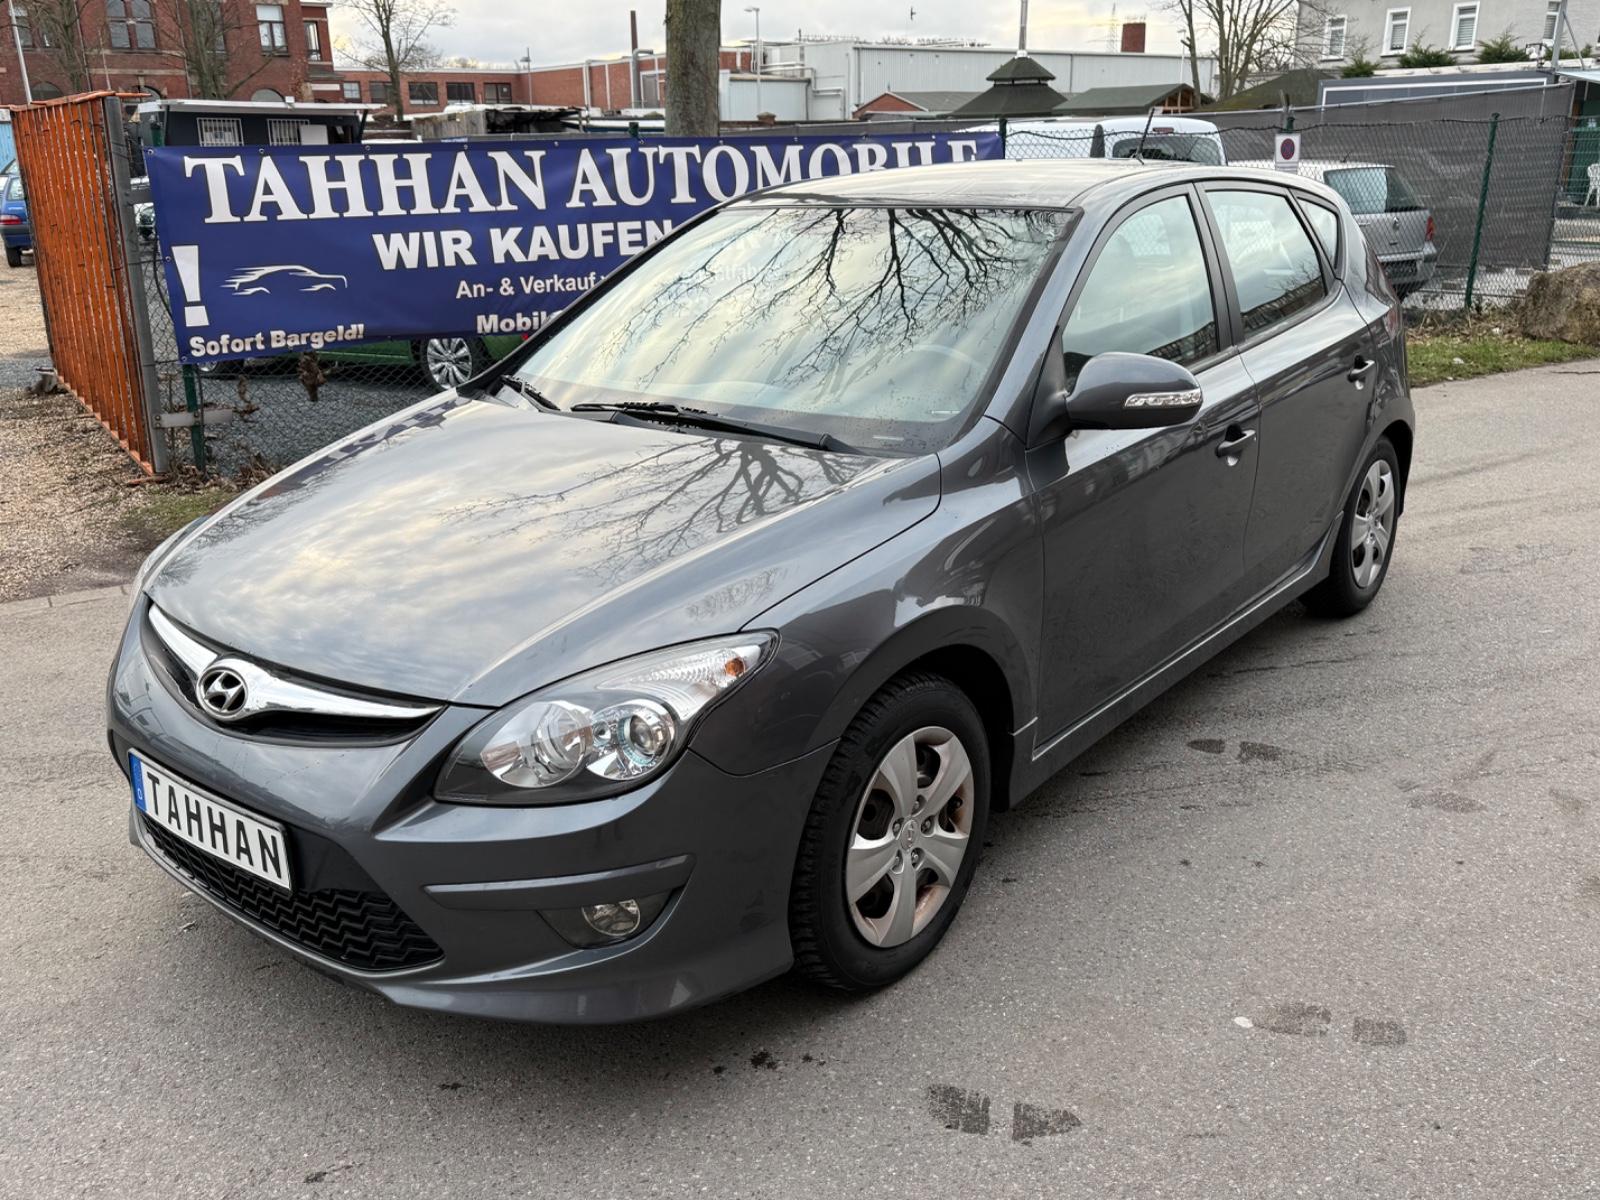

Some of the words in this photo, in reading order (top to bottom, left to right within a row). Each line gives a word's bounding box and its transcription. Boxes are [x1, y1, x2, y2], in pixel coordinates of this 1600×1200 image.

[184, 150, 546, 224] TAHHAN
[372, 230, 477, 270] WIR
[456, 279, 493, 299] An-
[499, 277, 516, 297] &
[520, 271, 597, 294] Verkauf
[189, 330, 265, 357] Sofort
[270, 323, 365, 349] Bargeld!
[147, 771, 282, 879] TAHHAN
